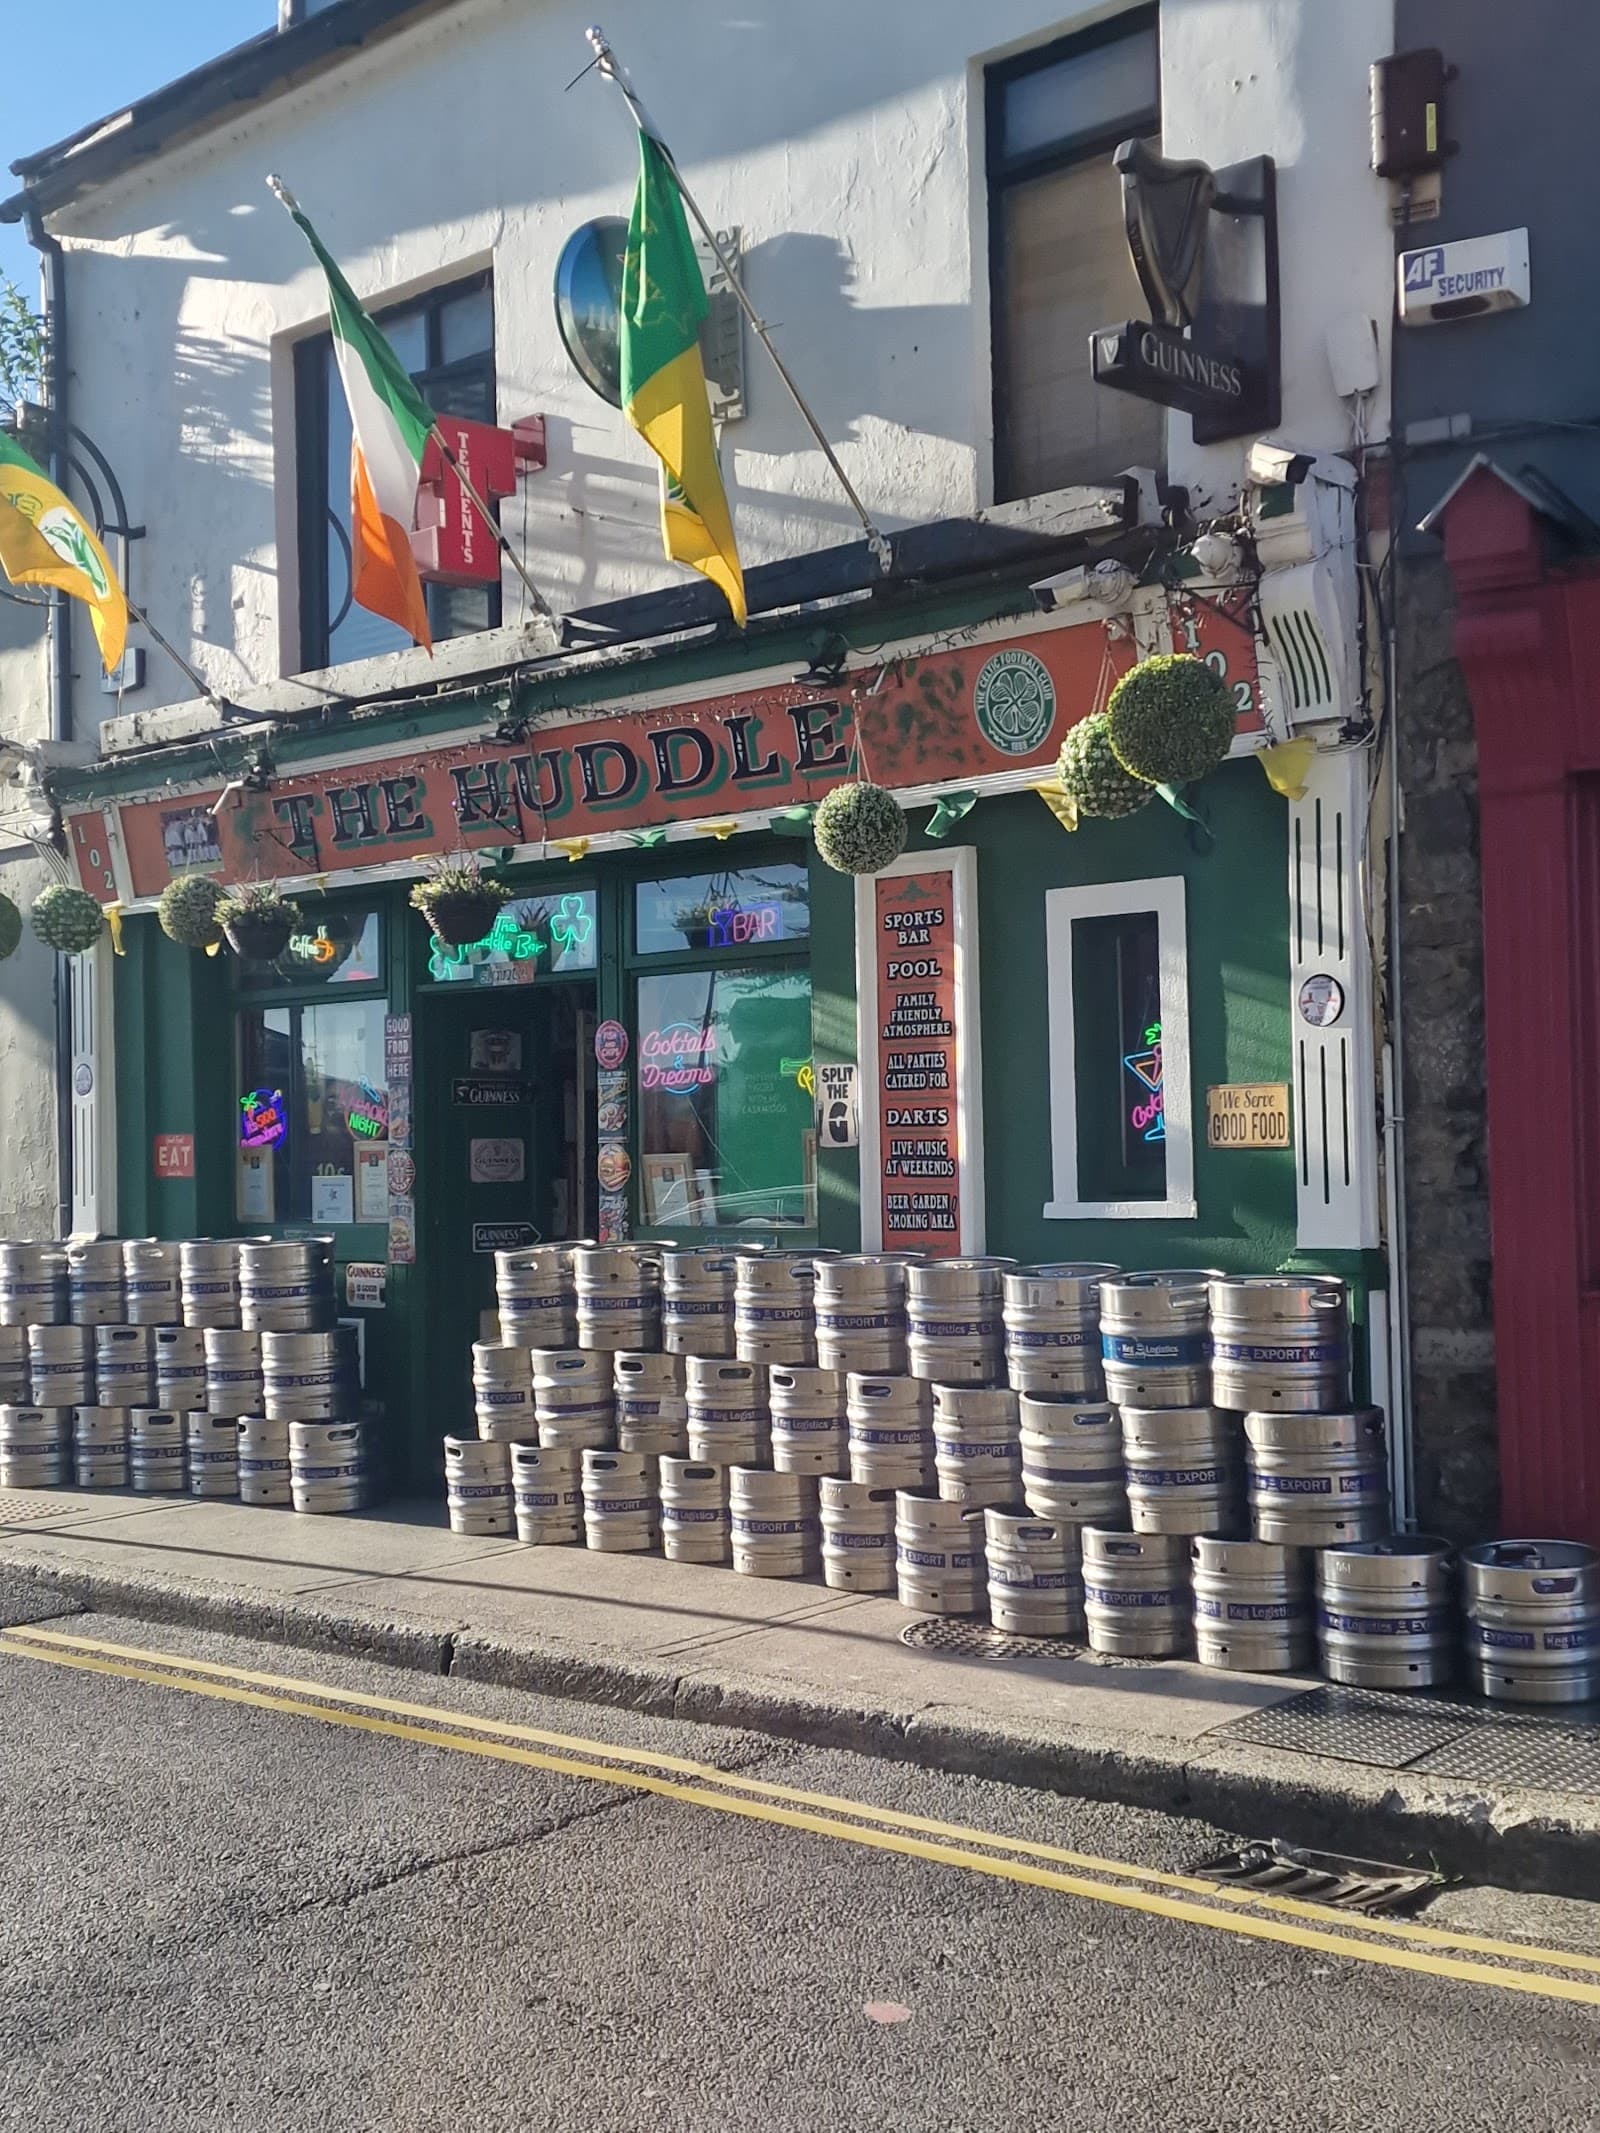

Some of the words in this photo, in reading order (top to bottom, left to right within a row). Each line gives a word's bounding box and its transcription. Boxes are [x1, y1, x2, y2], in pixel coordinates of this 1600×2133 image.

[1406, 252, 1438, 284] AF
[1439, 267, 1504, 296] SECURITY
[1140, 332, 1241, 395] GUINNESS
[1001, 653, 1039, 674] FOOTBALL
[272, 776, 426, 850] THE
[448, 700, 848, 824] HUDDLE
[77, 826, 115, 890] 102
[496, 916, 518, 937] The
[733, 909, 776, 942] BAR
[885, 909, 943, 929] SPORTS
[898, 929, 930, 945] BAR
[515, 934, 546, 958] Bar
[888, 961, 941, 978] POOL
[897, 993, 935, 1007] FAMILY
[891, 1008, 942, 1022] FRIENDLY
[387, 1018, 409, 1033] GOOD
[883, 1023, 951, 1037] ATMOSPHERE
[387, 1040, 409, 1055] FOOD
[642, 1026, 716, 1056] Cocktails
[888, 1055, 904, 1069] ALL
[907, 1053, 945, 1068] PARTIES
[387, 1063, 409, 1078] HERE
[643, 1064, 712, 1088] Dreams
[822, 1067, 853, 1082] SPLIT
[885, 1074, 926, 1088] CATERED
[929, 1073, 947, 1087] FOR
[470, 1088, 519, 1103] GUINNESS
[827, 1084, 848, 1099] THE
[1220, 1091, 1239, 1109] We
[1244, 1091, 1274, 1109] Serve
[887, 1109, 949, 1124] DARTS
[349, 1113, 380, 1137] NIGHT
[1213, 1113, 1246, 1141] GOOD
[1252, 1112, 1286, 1140] FOOD
[891, 1141, 914, 1155] LIVE
[916, 1140, 947, 1155] MUSIC
[159, 1146, 191, 1167] EAT
[885, 1161, 898, 1175] AT
[900, 1161, 954, 1175] WEEKENDS
[887, 1195, 909, 1209] BEER
[912, 1195, 948, 1209] GARDEN
[888, 1214, 928, 1229] SMOKING
[931, 1214, 955, 1229] AREA
[476, 1228, 519, 1241] GUINNESS
[348, 1265, 385, 1278] GUINNESS
[839, 1316, 877, 1328] EXPORT
[928, 1323, 965, 1335] Logistics
[1122, 1344, 1134, 1354] Keg
[1146, 1344, 1179, 1354] Logistics
[1254, 1349, 1301, 1360] EXPORT
[793, 1419, 828, 1430] Logistics
[879, 1431, 895, 1443] Keg
[965, 1445, 1006, 1456] EXPORT
[1280, 1478, 1329, 1492] EXPORT
[605, 1501, 641, 1511] EXPORT
[680, 1510, 715, 1522] Logistics
[752, 1522, 788, 1533] EXPORT
[844, 1534, 881, 1546] Logistics
[908, 1551, 942, 1566] EXPORT
[954, 1556, 972, 1567] Keg
[1103, 1593, 1143, 1606] EXPORT
[1151, 1594, 1170, 1606] Keg
[1229, 1606, 1249, 1620] Keg
[1329, 1616, 1343, 1631] Keg
[1347, 1619, 1392, 1633] Logistics
[1483, 1631, 1531, 1647] EXPORT
[1548, 1635, 1568, 1649] Keg
